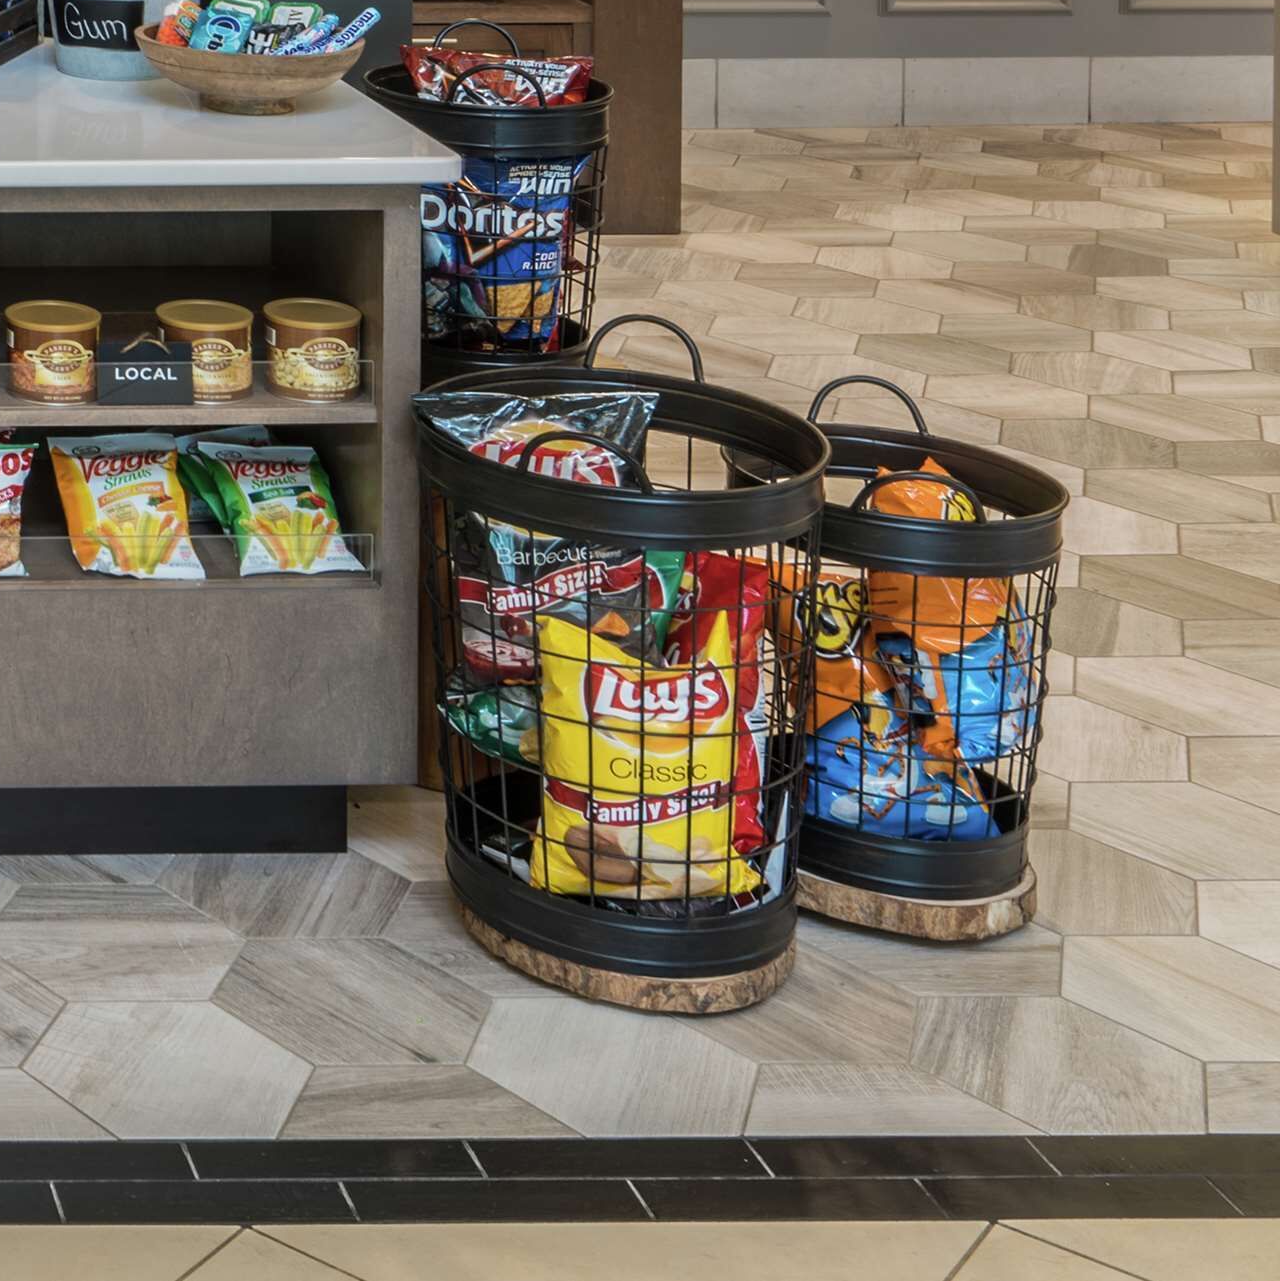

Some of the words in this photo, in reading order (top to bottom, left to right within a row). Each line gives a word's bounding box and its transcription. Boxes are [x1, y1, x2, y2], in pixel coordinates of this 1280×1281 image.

[64, 1, 127, 41] Gum
[334, 10, 375, 47] mentos
[421, 194, 564, 238] Doritos
[114, 367, 178, 381] LOCAL
[80, 450, 173, 484] Veggie
[103, 468, 152, 490] Straws
[223, 458, 310, 481] Veggie
[251, 475, 297, 488] Straws
[496, 546, 588, 566] Barbecue
[487, 583, 551, 612] Family
[553, 566, 603, 596] Size!
[593, 668, 721, 722] Lay's
[609, 757, 708, 782] Classic
[586, 797, 662, 823] Family
[667, 784, 717, 816] Size!
